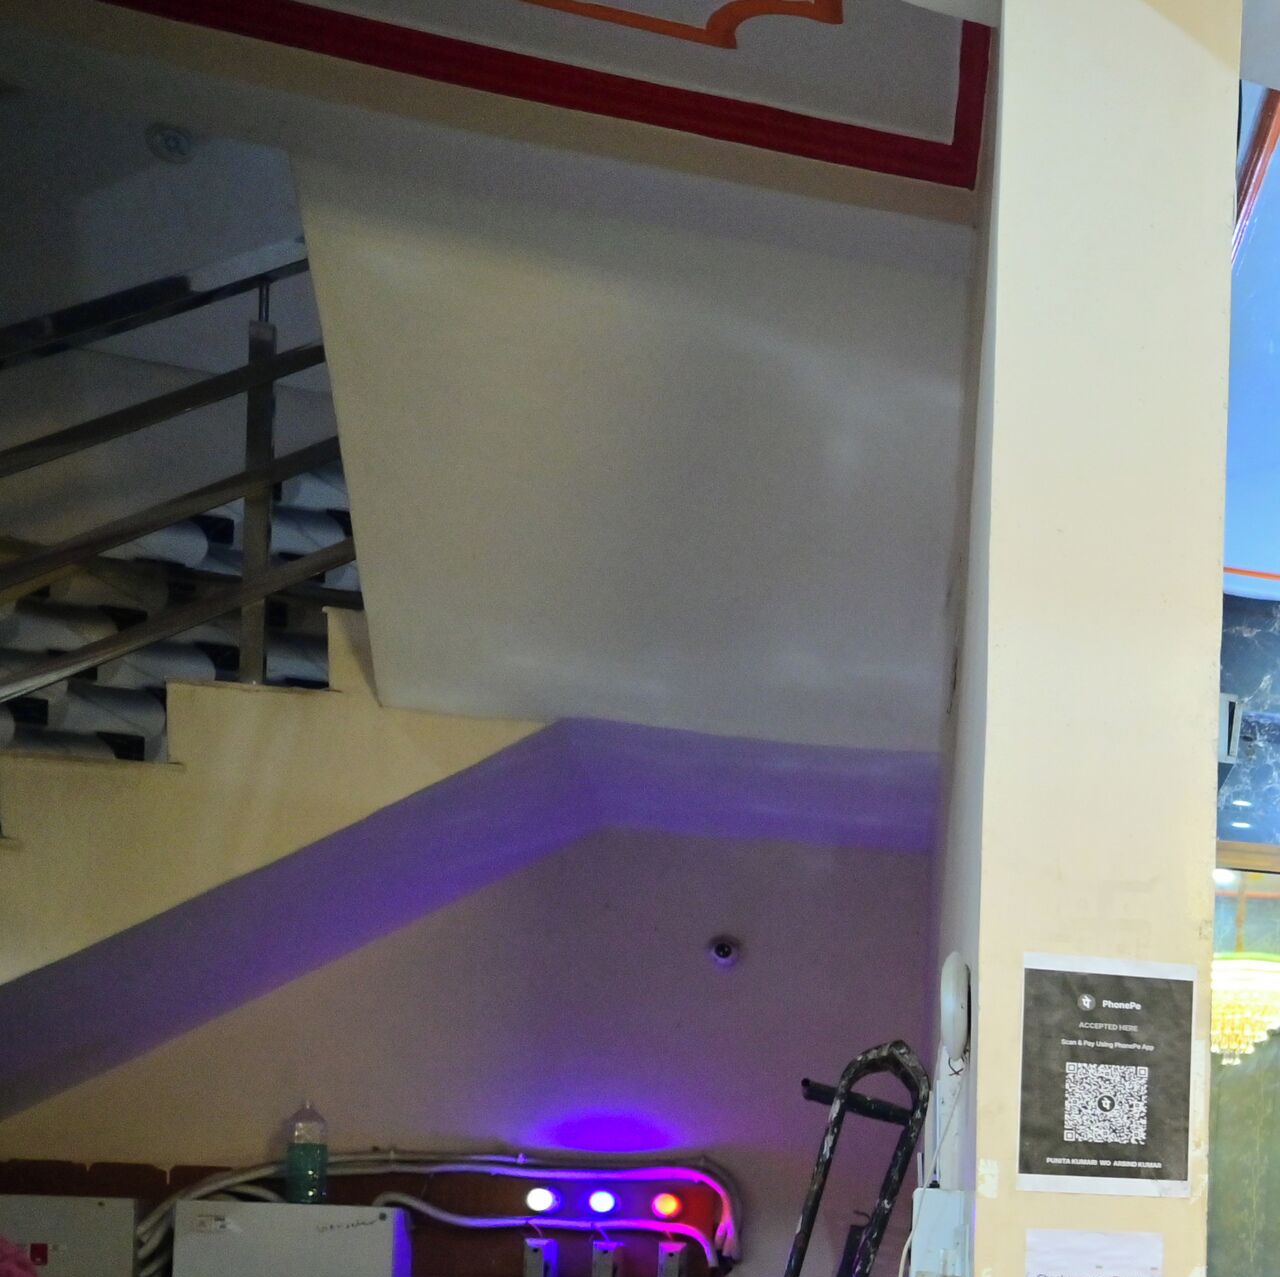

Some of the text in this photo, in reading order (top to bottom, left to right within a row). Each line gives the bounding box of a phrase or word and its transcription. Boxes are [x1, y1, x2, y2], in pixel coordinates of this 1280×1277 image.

[1102, 999, 1142, 1011] PhonePe
[1078, 1021, 1138, 1033] ACCEPTED HERE
[1061, 1038, 1077, 1046] Scan
[1083, 1039, 1095, 1049] Pay
[1095, 1041, 1113, 1050] Using
[1114, 1042, 1141, 1050] PhonePe
[1141, 1044, 1154, 1052] App
